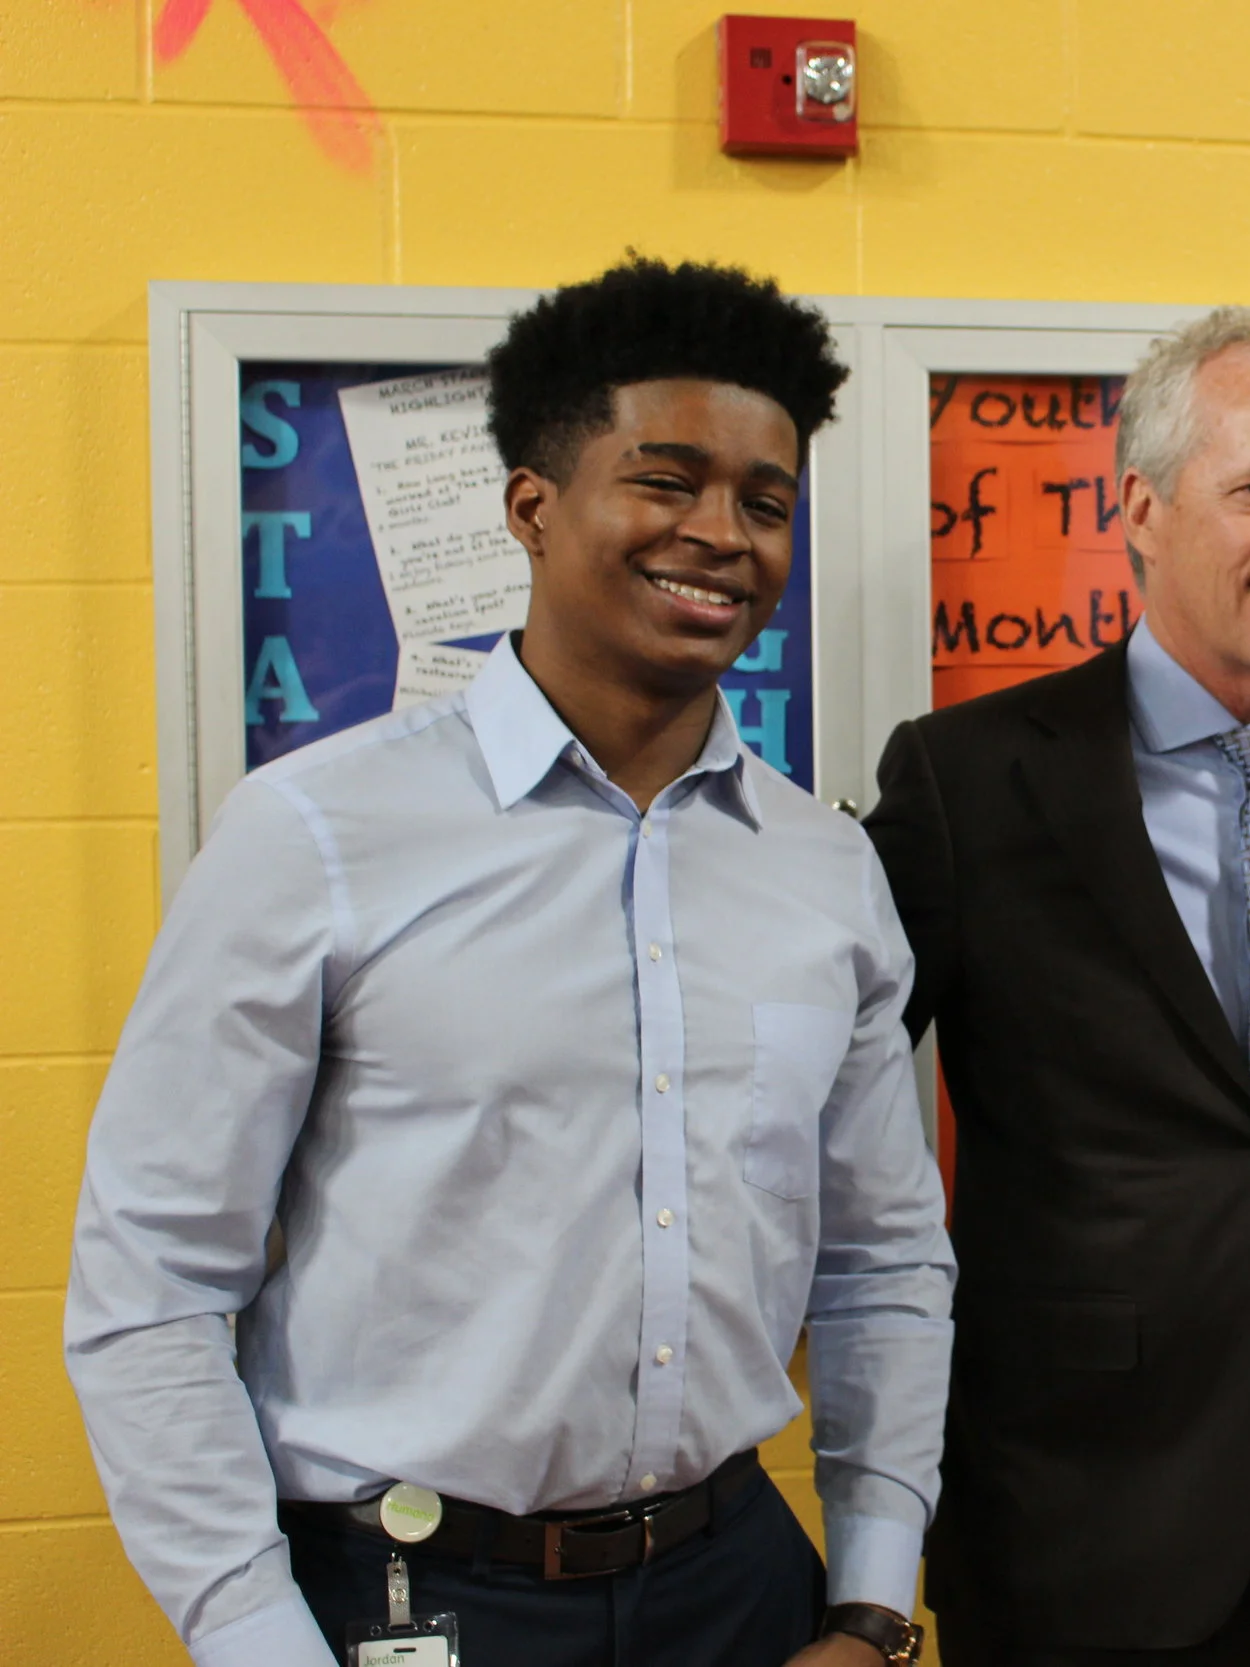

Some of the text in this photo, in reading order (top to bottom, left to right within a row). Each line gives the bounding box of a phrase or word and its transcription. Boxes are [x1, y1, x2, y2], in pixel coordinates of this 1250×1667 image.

[390, 385, 487, 415] HIGHLIGHT
[931, 467, 998, 559] of
[364, 1653, 406, 1667] Jordan
